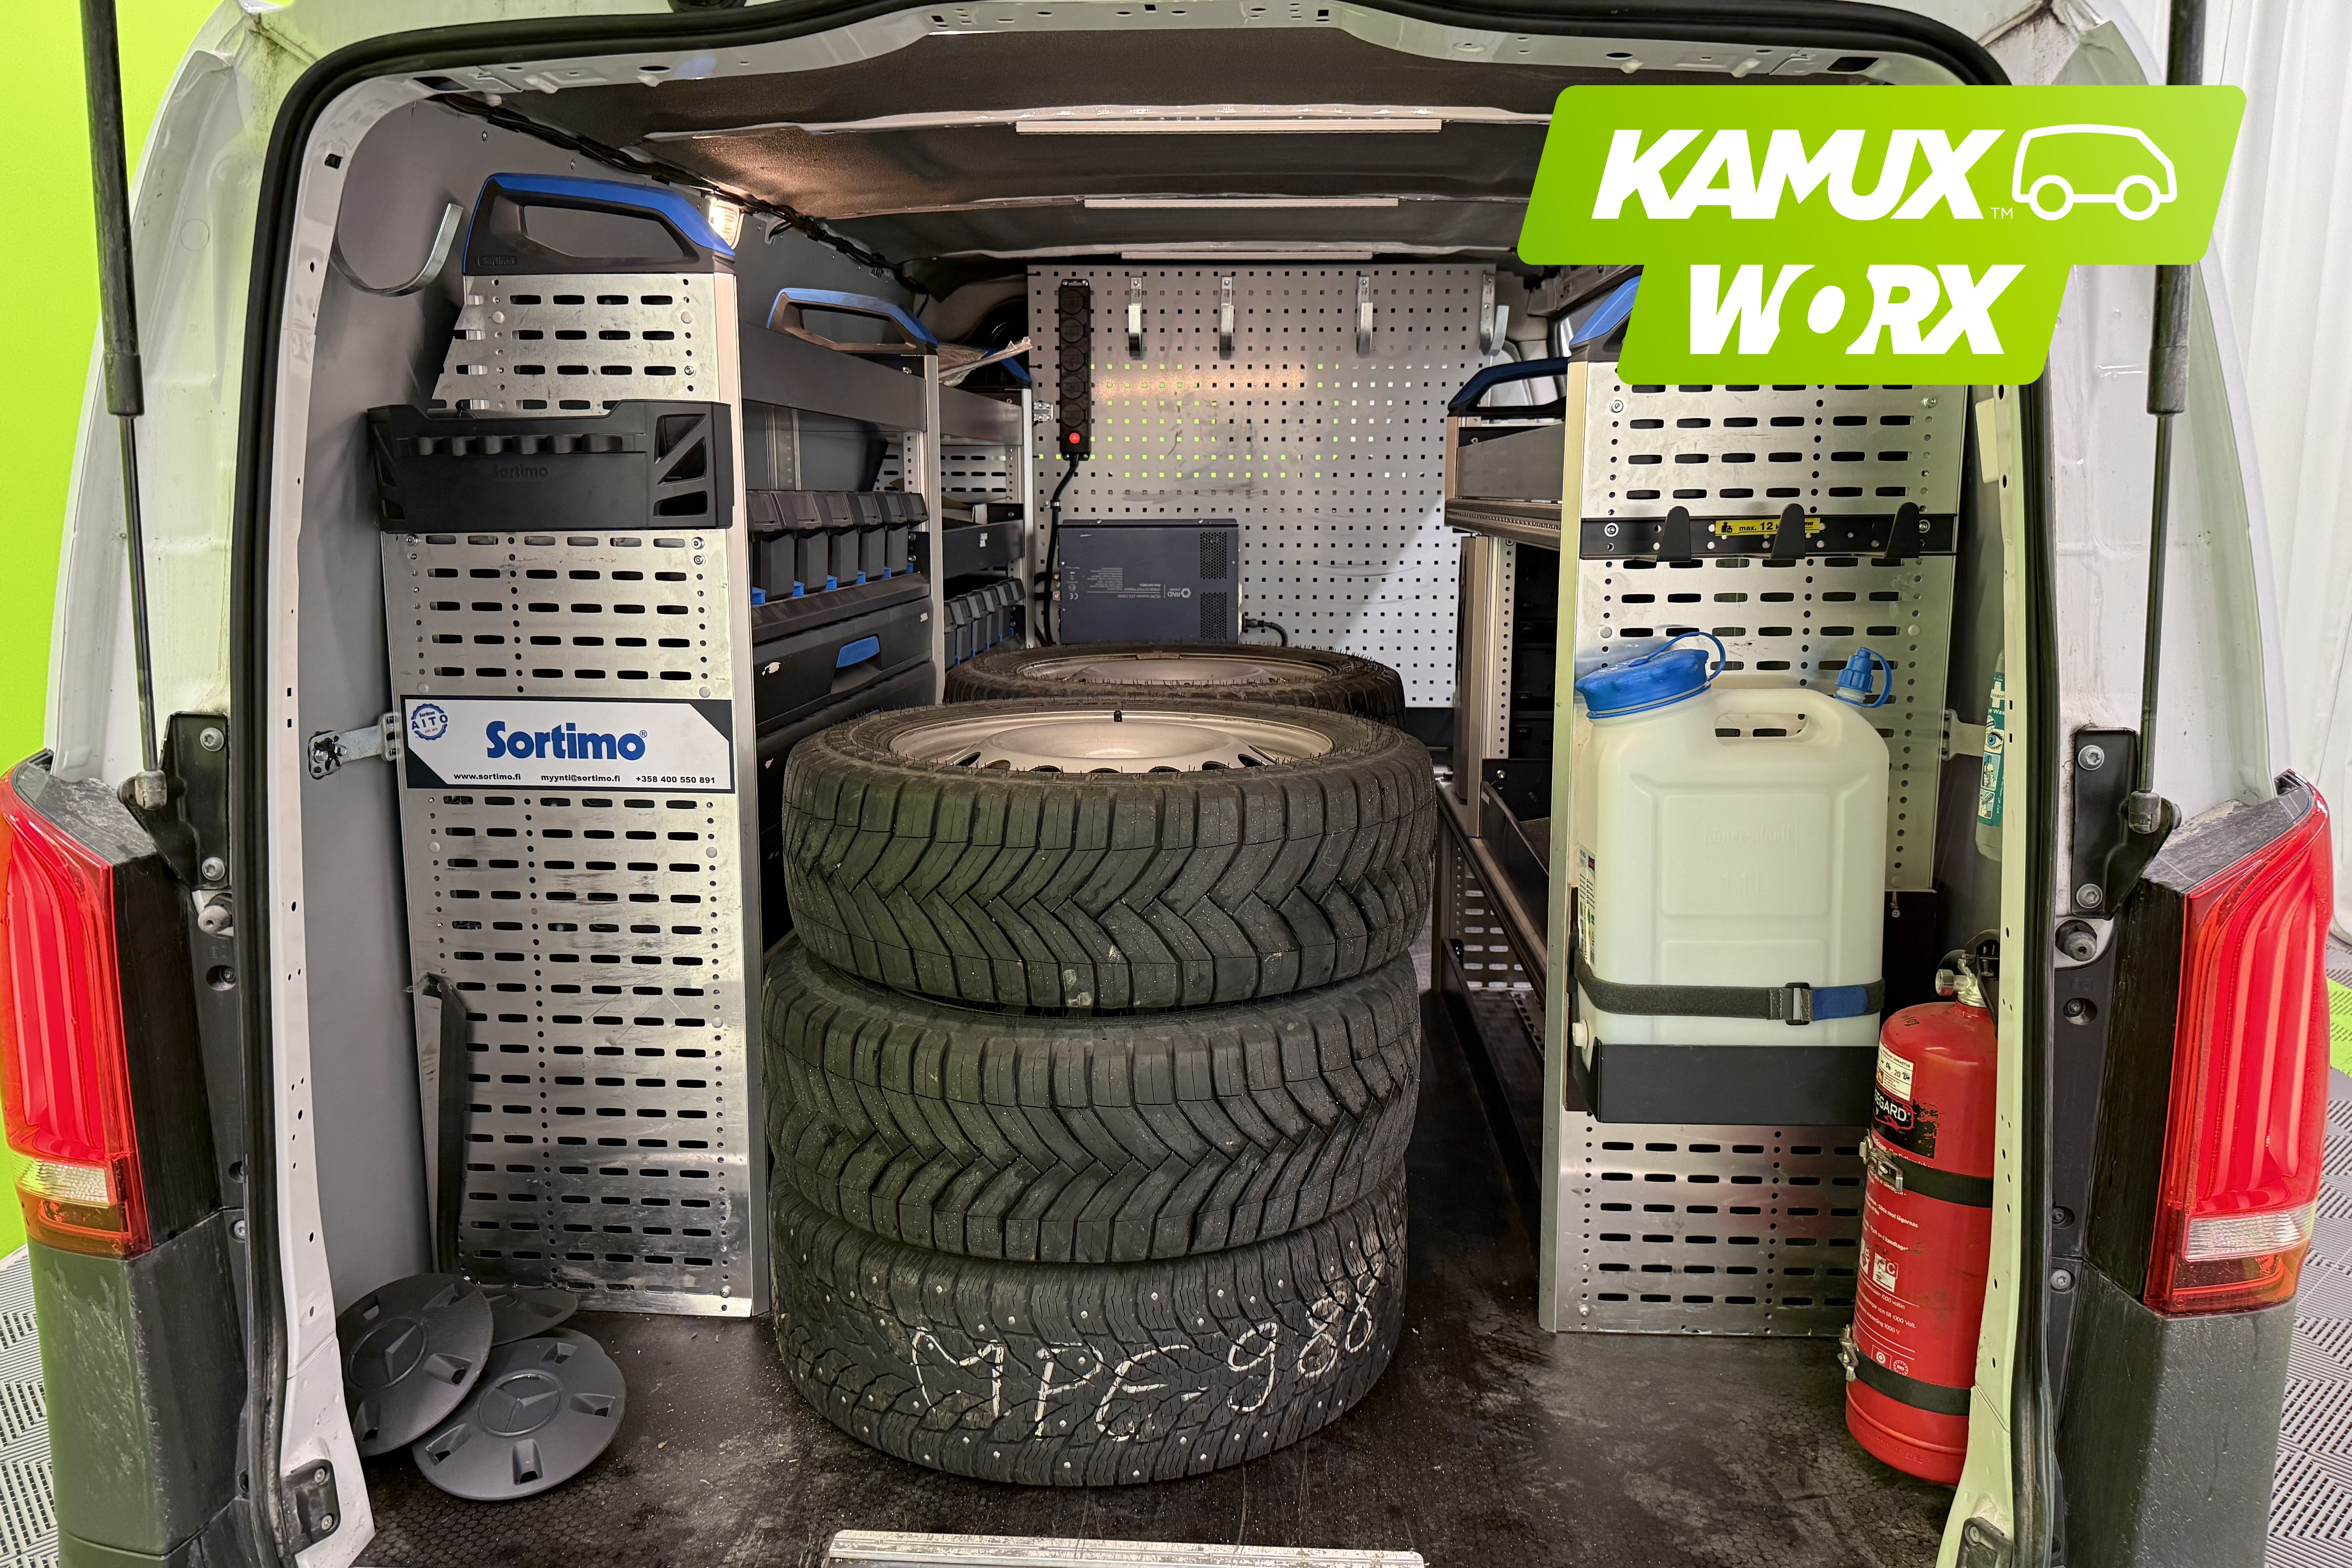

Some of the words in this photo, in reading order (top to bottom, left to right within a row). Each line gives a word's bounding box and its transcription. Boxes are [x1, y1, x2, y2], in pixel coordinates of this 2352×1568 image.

[1760, 522, 1773, 530] 12
[412, 714, 448, 730] AITO
[486, 721, 645, 761] Sortimo
[541, 774, 621, 783] myynti@sortimo.fi
[1897, 1215, 1918, 1228] lågornas
[1884, 1323, 1895, 1333] 1000
